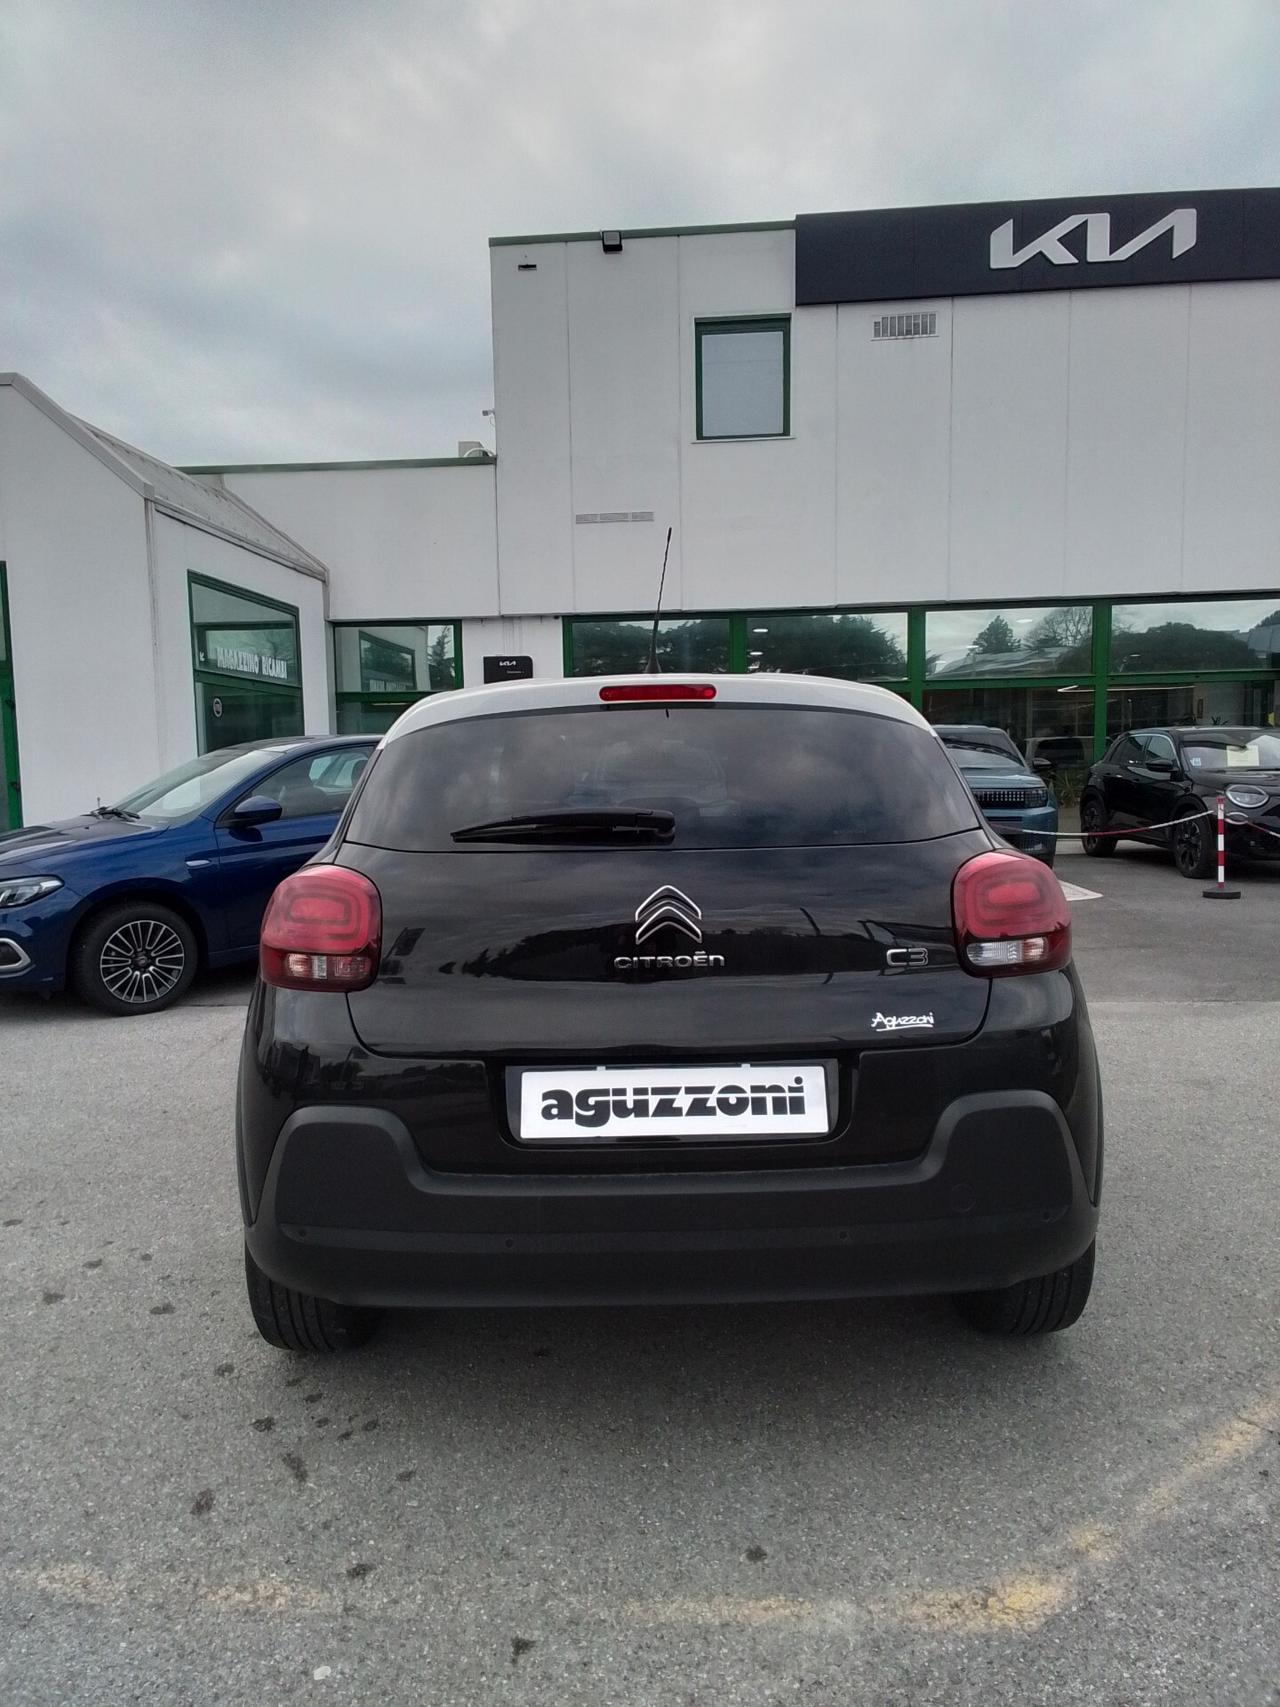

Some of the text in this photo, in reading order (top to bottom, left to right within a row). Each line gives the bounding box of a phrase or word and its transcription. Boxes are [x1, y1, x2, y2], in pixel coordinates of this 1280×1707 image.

[990, 208, 1197, 270] KIA
[261, 655, 288, 679] RICAMBI
[886, 947, 928, 967] C3
[540, 1075, 806, 1128] aguzzoni
